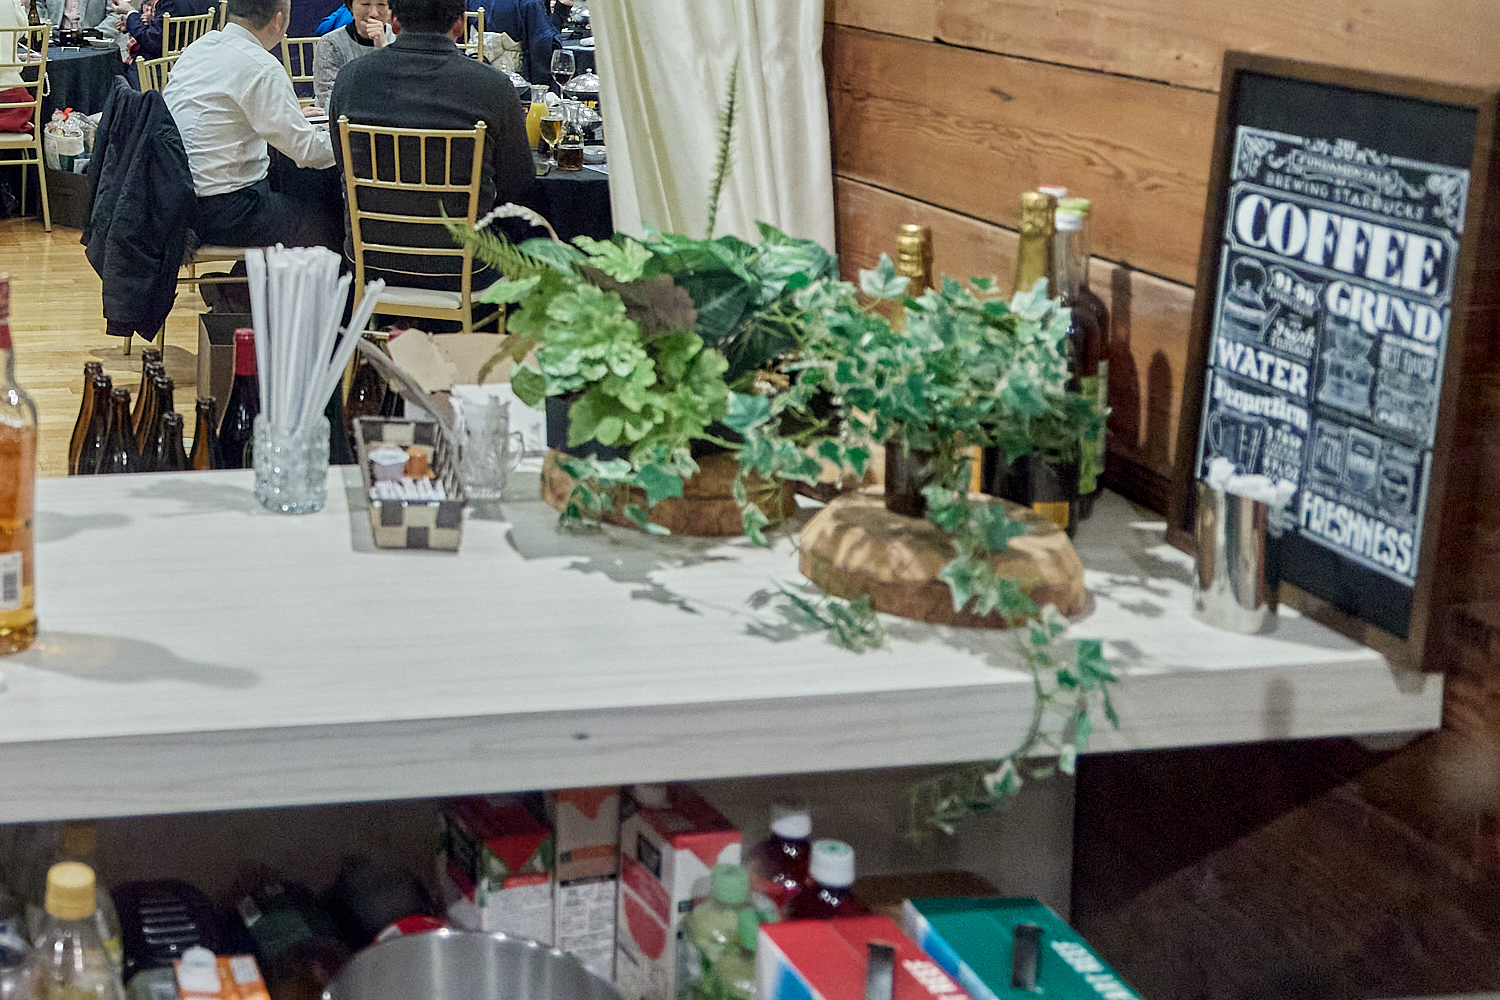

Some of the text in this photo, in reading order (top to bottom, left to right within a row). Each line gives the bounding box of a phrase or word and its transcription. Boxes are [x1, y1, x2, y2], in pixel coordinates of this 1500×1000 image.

[1265, 171, 1425, 220] BREWING STARBUCKS
[1235, 194, 1443, 296] COFFEE
[1325, 280, 1443, 342] GRIND
[1217, 337, 1309, 398] WATER
[1300, 490, 1413, 574] FRESHNESS
